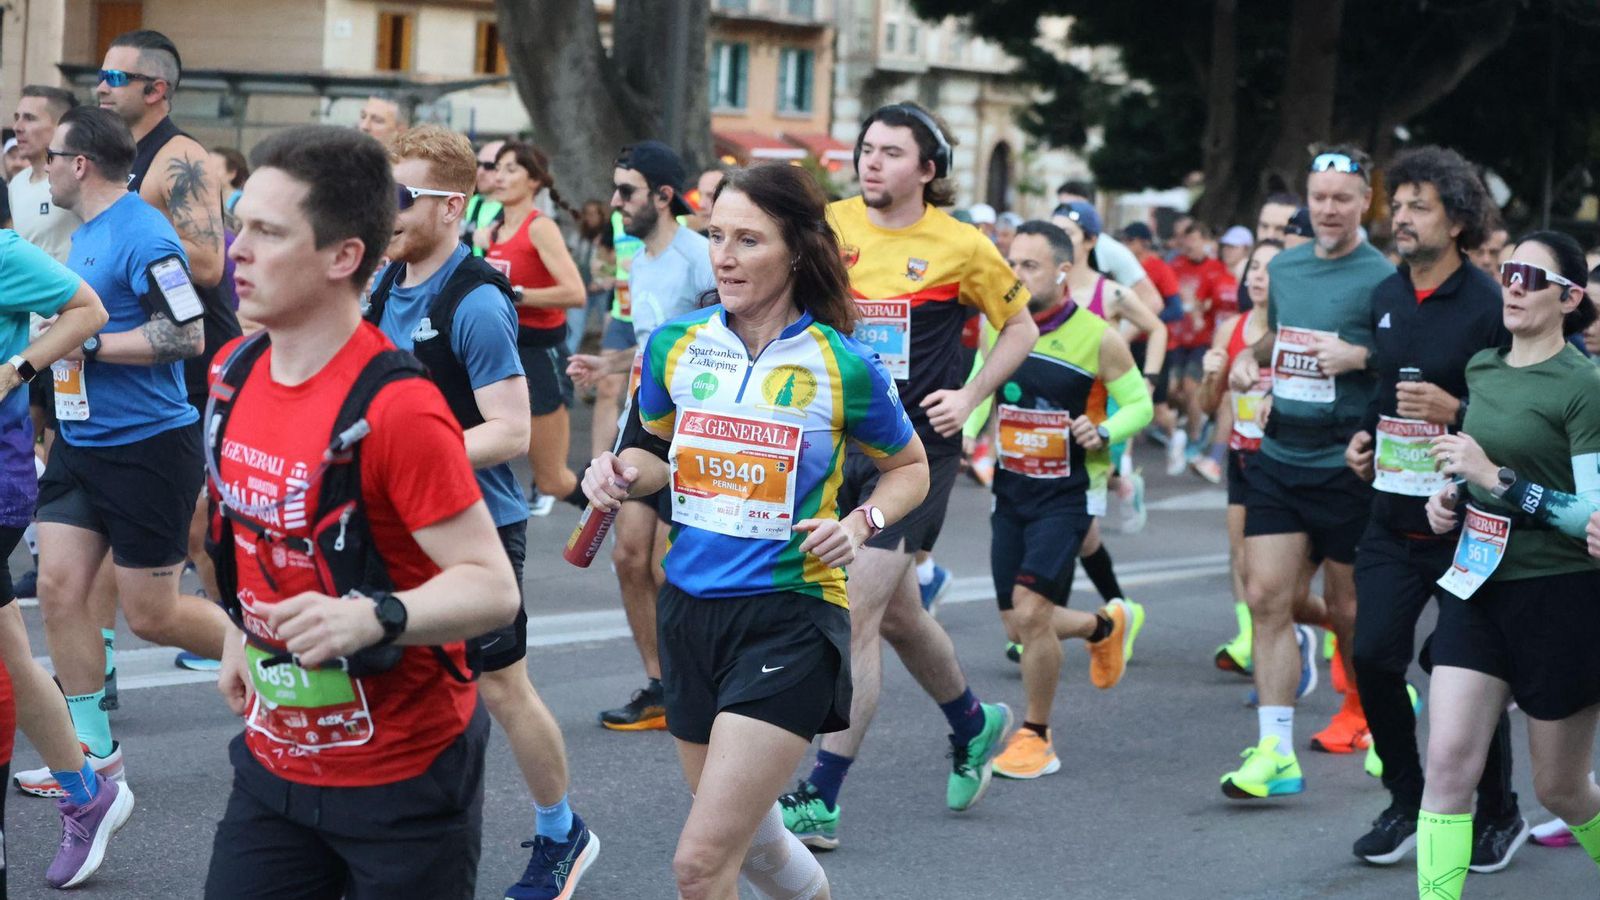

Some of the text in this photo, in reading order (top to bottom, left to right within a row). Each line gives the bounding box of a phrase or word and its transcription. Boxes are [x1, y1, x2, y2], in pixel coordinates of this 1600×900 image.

[857, 303, 902, 317] NERALI
[688, 344, 743, 360] Sparbanken
[689, 356, 738, 373] Lidköping
[1283, 352, 1319, 371] 16172
[693, 379, 715, 391] dina
[705, 418, 789, 447] GENERALI
[1013, 431, 1049, 449] 2853
[223, 441, 285, 477] GENERALI
[694, 455, 766, 485] 15940
[712, 479, 749, 493] PERNILLA
[1521, 483, 1544, 514] OTSO
[748, 510, 770, 519] 21K
